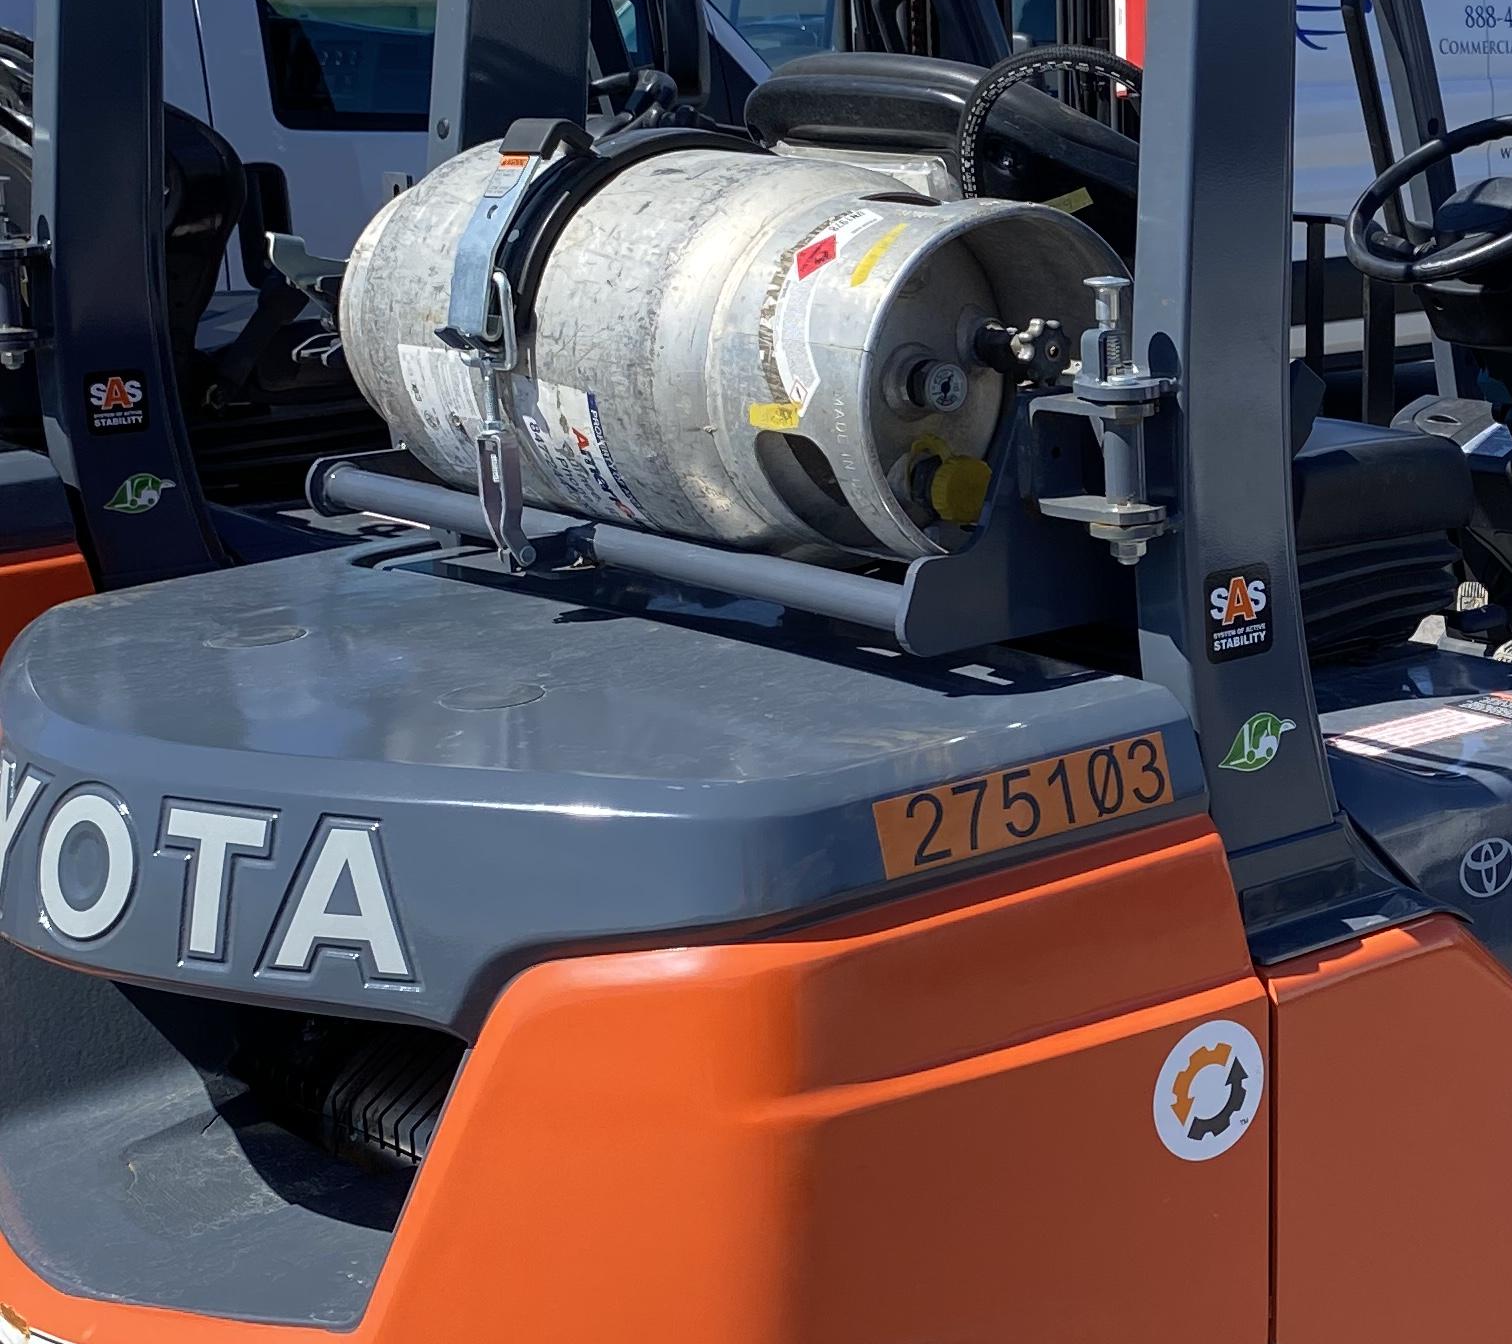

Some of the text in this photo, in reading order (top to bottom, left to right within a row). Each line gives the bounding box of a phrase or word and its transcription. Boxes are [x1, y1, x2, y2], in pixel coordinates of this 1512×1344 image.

[90, 376, 143, 410] SAS
[94, 415, 143, 427] STABILITY
[1210, 576, 1267, 626] SAS
[1213, 630, 1267, 652] STABILITY
[906, 739, 1165, 866] 275103
